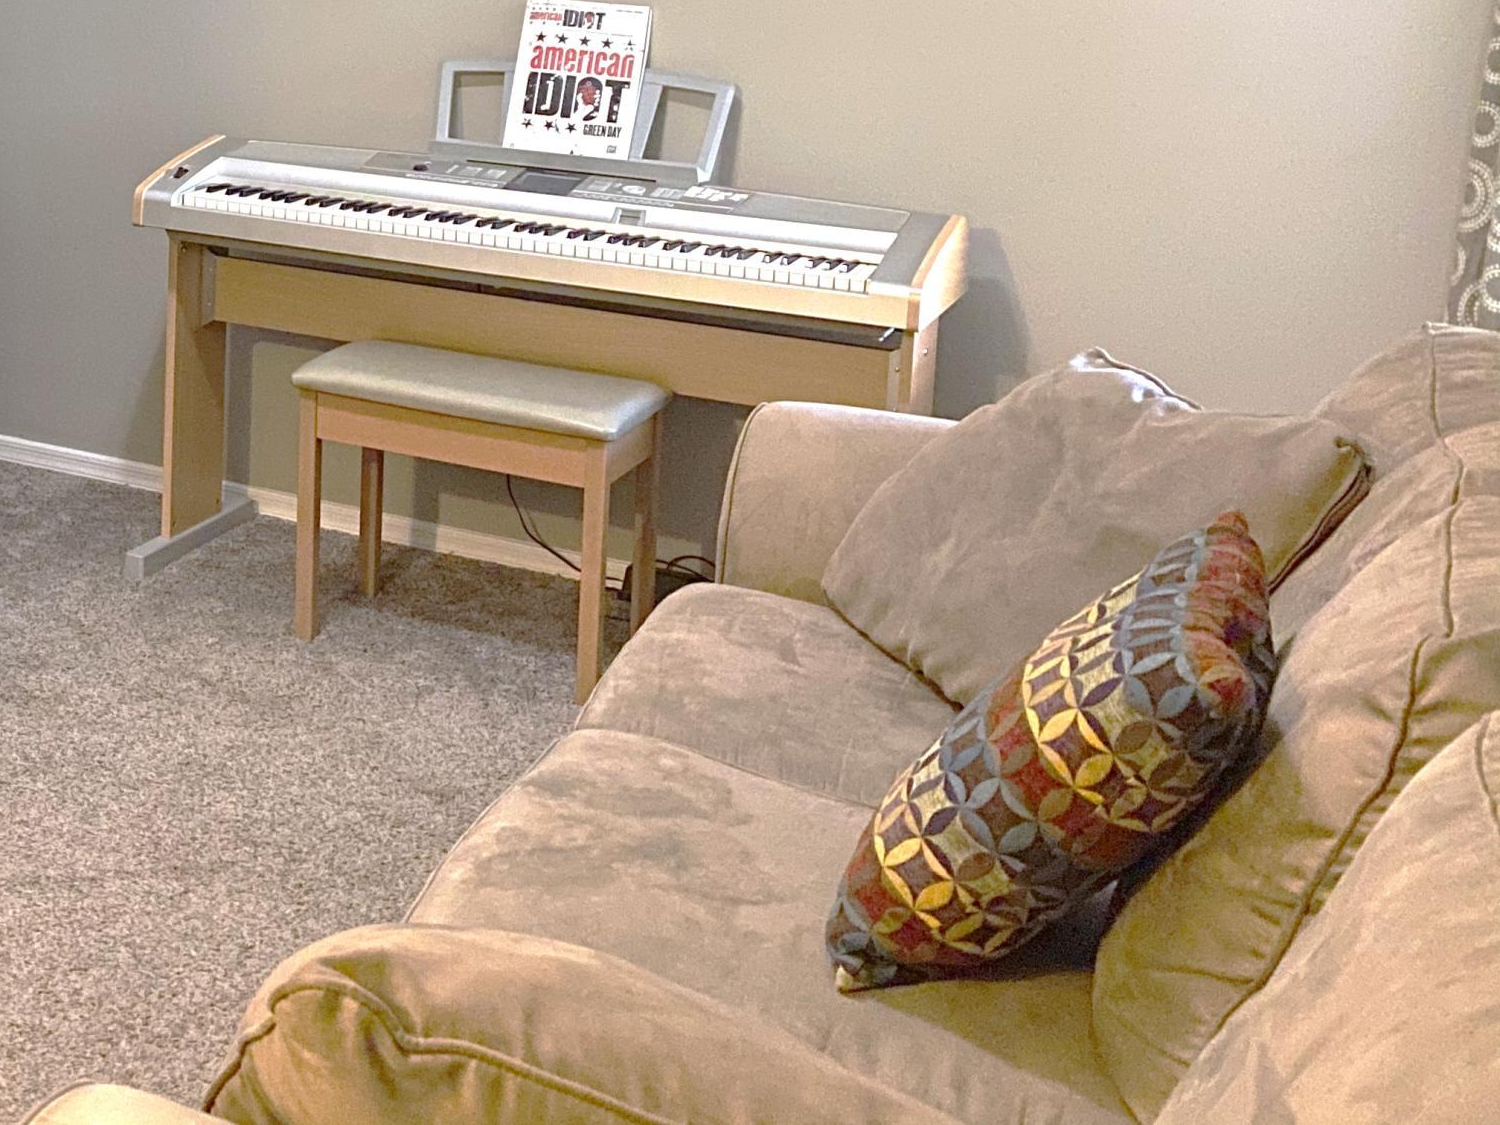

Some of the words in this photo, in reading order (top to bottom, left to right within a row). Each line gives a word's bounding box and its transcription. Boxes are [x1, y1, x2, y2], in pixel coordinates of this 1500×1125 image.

[530, 45, 635, 78] american
[523, 71, 631, 123] IDIOT
[582, 123, 606, 138] GREEN
[606, 125, 622, 139] DAY
